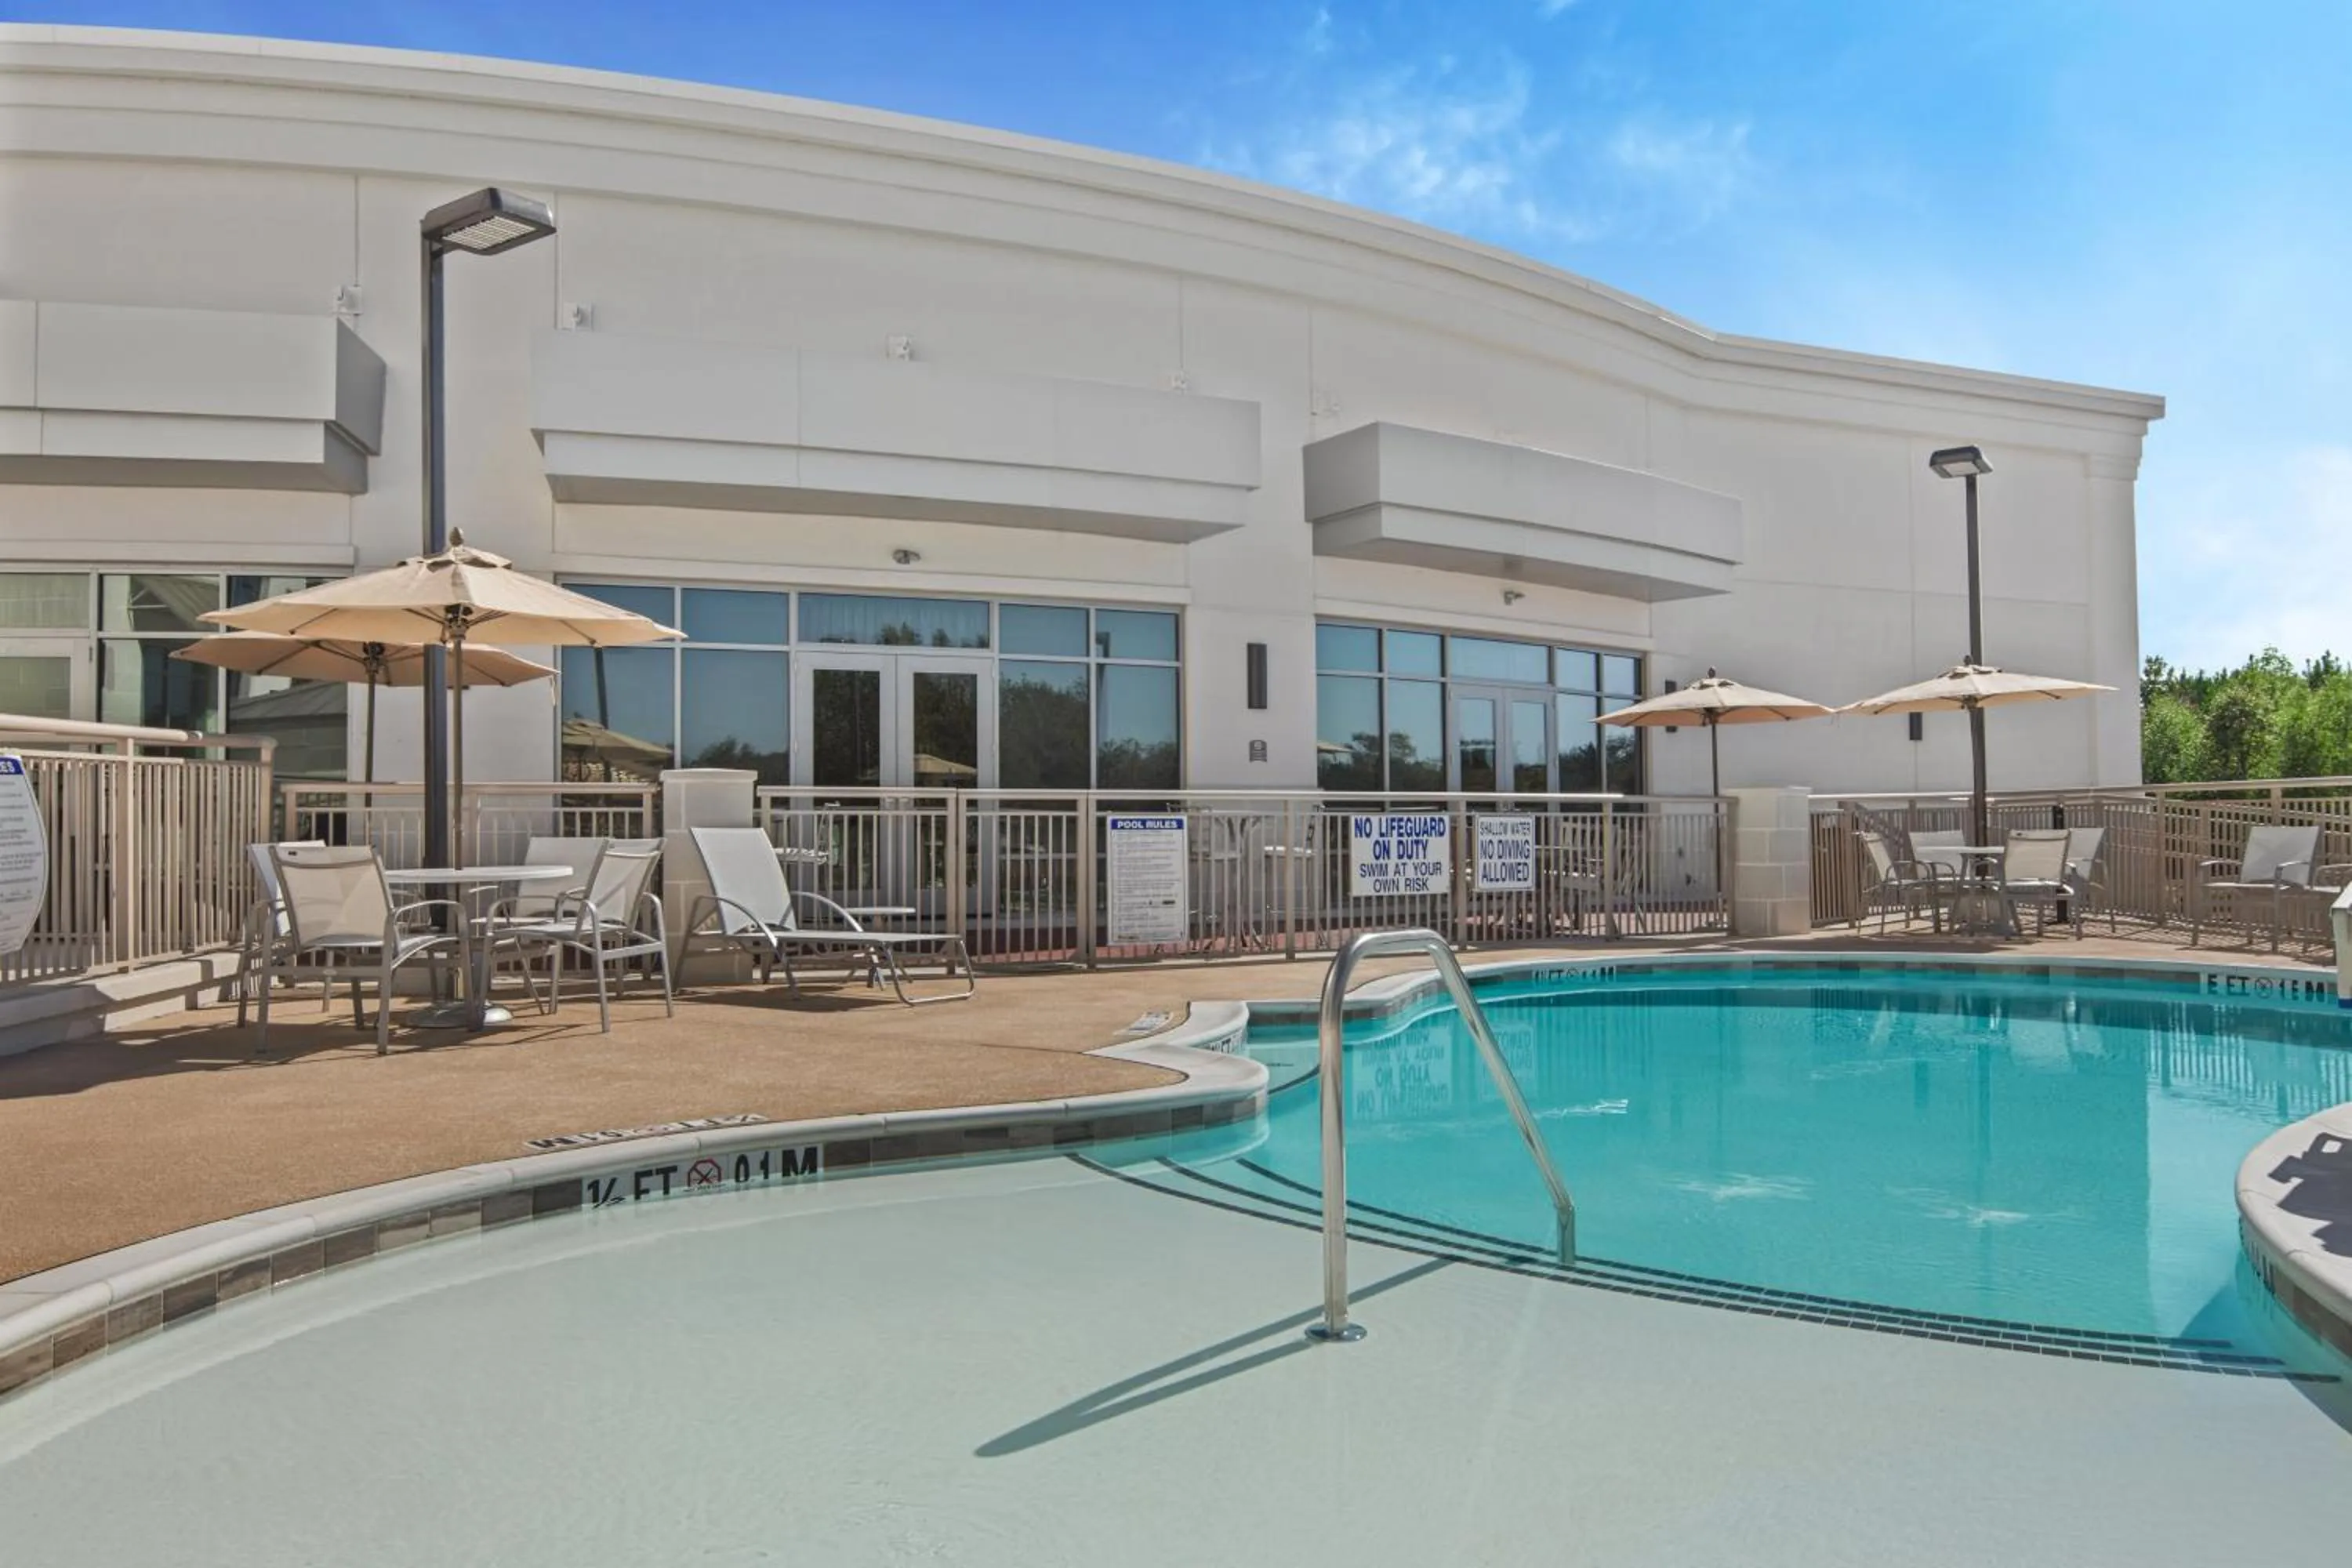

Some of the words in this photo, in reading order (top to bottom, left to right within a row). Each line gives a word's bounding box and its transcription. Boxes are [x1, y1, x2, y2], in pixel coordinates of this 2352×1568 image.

[1117, 820, 1144, 829] POOL
[1146, 819, 1178, 829] RULES
[1354, 817, 1372, 838] NO
[1379, 817, 1446, 838] LIFEGUARD
[1373, 840, 1391, 860] ON
[1397, 839, 1429, 859] DUTY
[1480, 839, 1494, 859] NO
[1497, 839, 1530, 859] DIVING
[1359, 863, 1388, 877] SWIM
[1393, 863, 1407, 877] AT
[1413, 861, 1442, 877] YOUR
[1482, 862, 1530, 883] ALLOWED
[1373, 878, 1399, 892] OWN
[1404, 877, 1429, 891] RISK
[634, 1165, 678, 1201] FT
[782, 1146, 818, 1178] M
